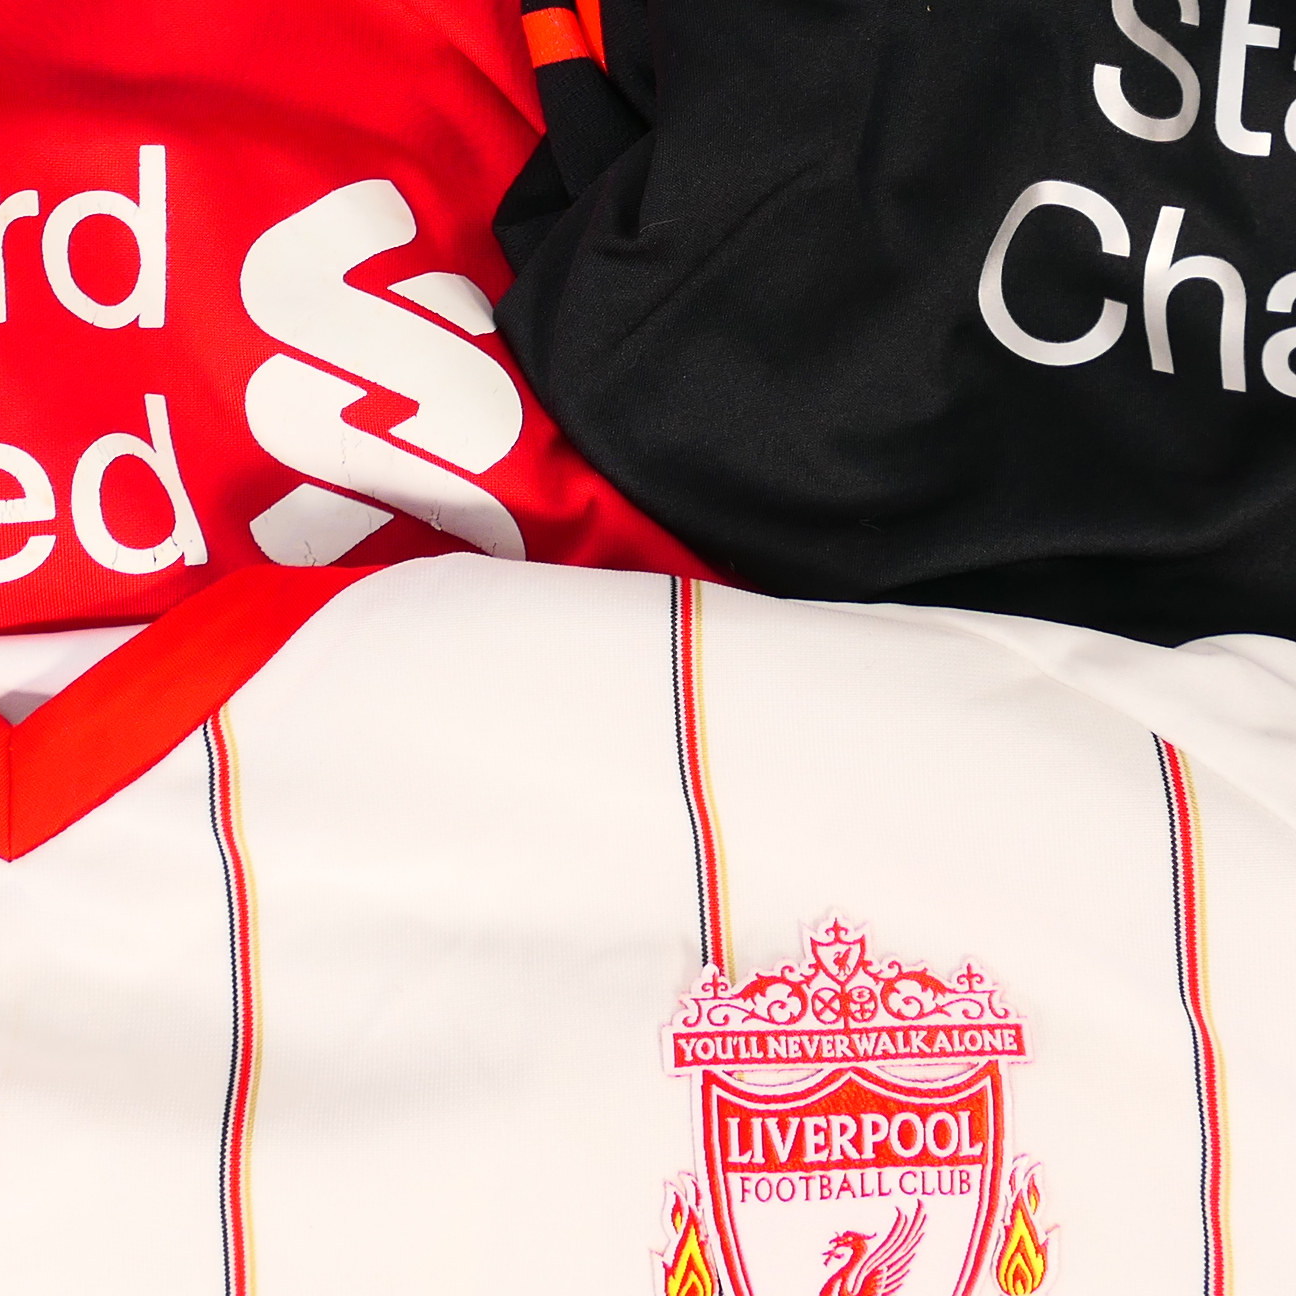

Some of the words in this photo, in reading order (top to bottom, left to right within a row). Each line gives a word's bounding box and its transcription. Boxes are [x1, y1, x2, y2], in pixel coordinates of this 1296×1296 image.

[677, 1031, 766, 1062] YOU'LL
[766, 1033, 853, 1061] NEVER
[851, 1029, 934, 1056] WALK
[927, 1028, 1018, 1055] ALONE
[726, 1109, 985, 1165] LIVERPOOL
[740, 1171, 893, 1203] FOOTBALL
[898, 1169, 972, 1197] CLUB
